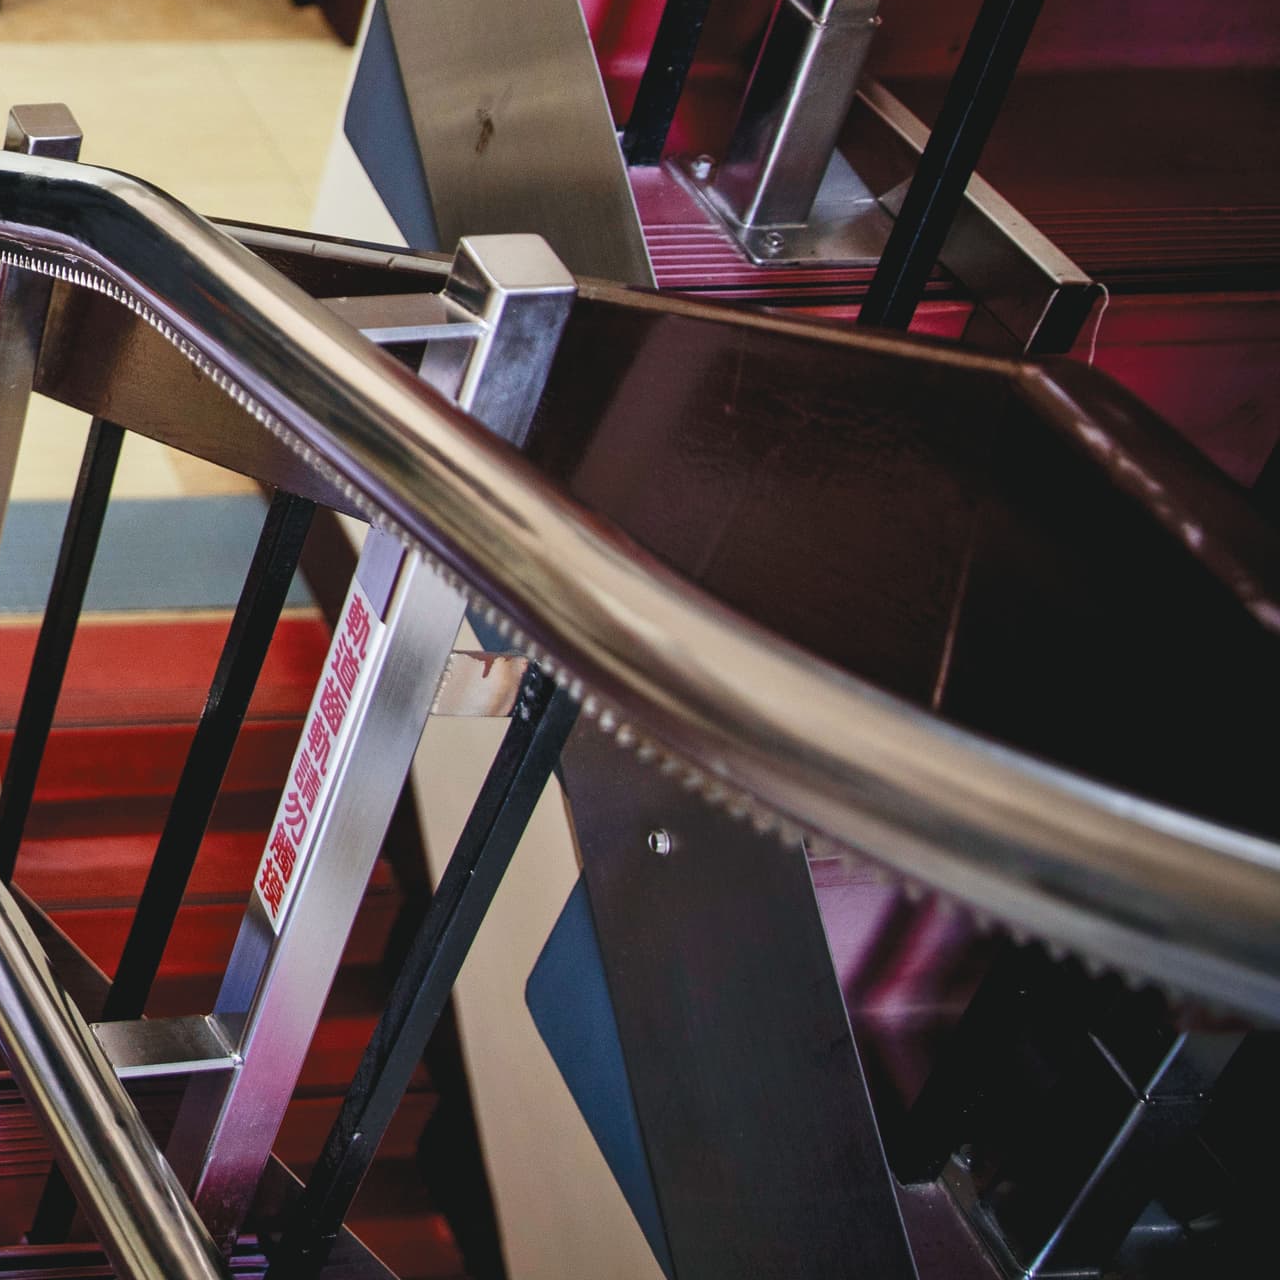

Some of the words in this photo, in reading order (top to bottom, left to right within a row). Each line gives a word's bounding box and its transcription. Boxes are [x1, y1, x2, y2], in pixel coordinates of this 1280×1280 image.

[259, 593, 372, 919] 軌道齒軌請勿觸摸
